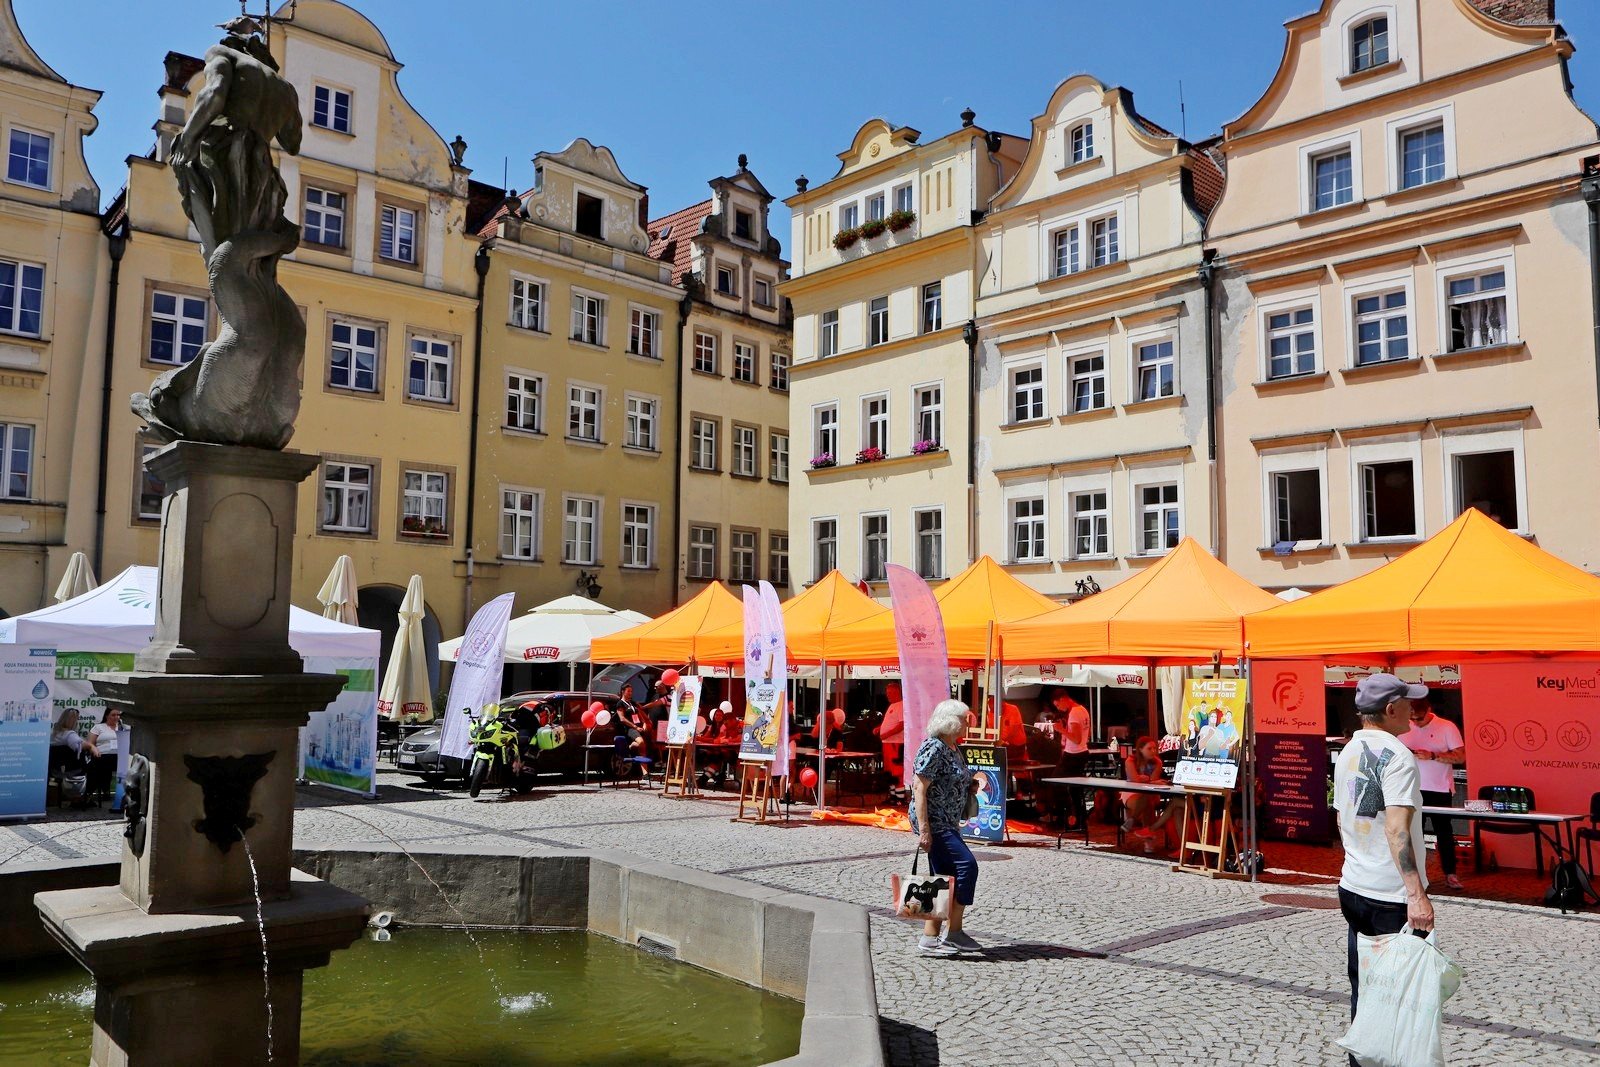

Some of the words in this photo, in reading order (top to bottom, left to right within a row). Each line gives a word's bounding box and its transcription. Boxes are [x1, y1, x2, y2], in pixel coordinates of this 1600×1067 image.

[528, 647, 557, 656] ŻYWIEC
[1192, 681, 1237, 692] MOC
[1537, 677, 1596, 691] KeyMed
[1261, 717, 1289, 726] Health
[1292, 717, 1317, 729] Space
[966, 749, 993, 759] OBCY
[1522, 760, 1580, 769] WYZNACZAMY
